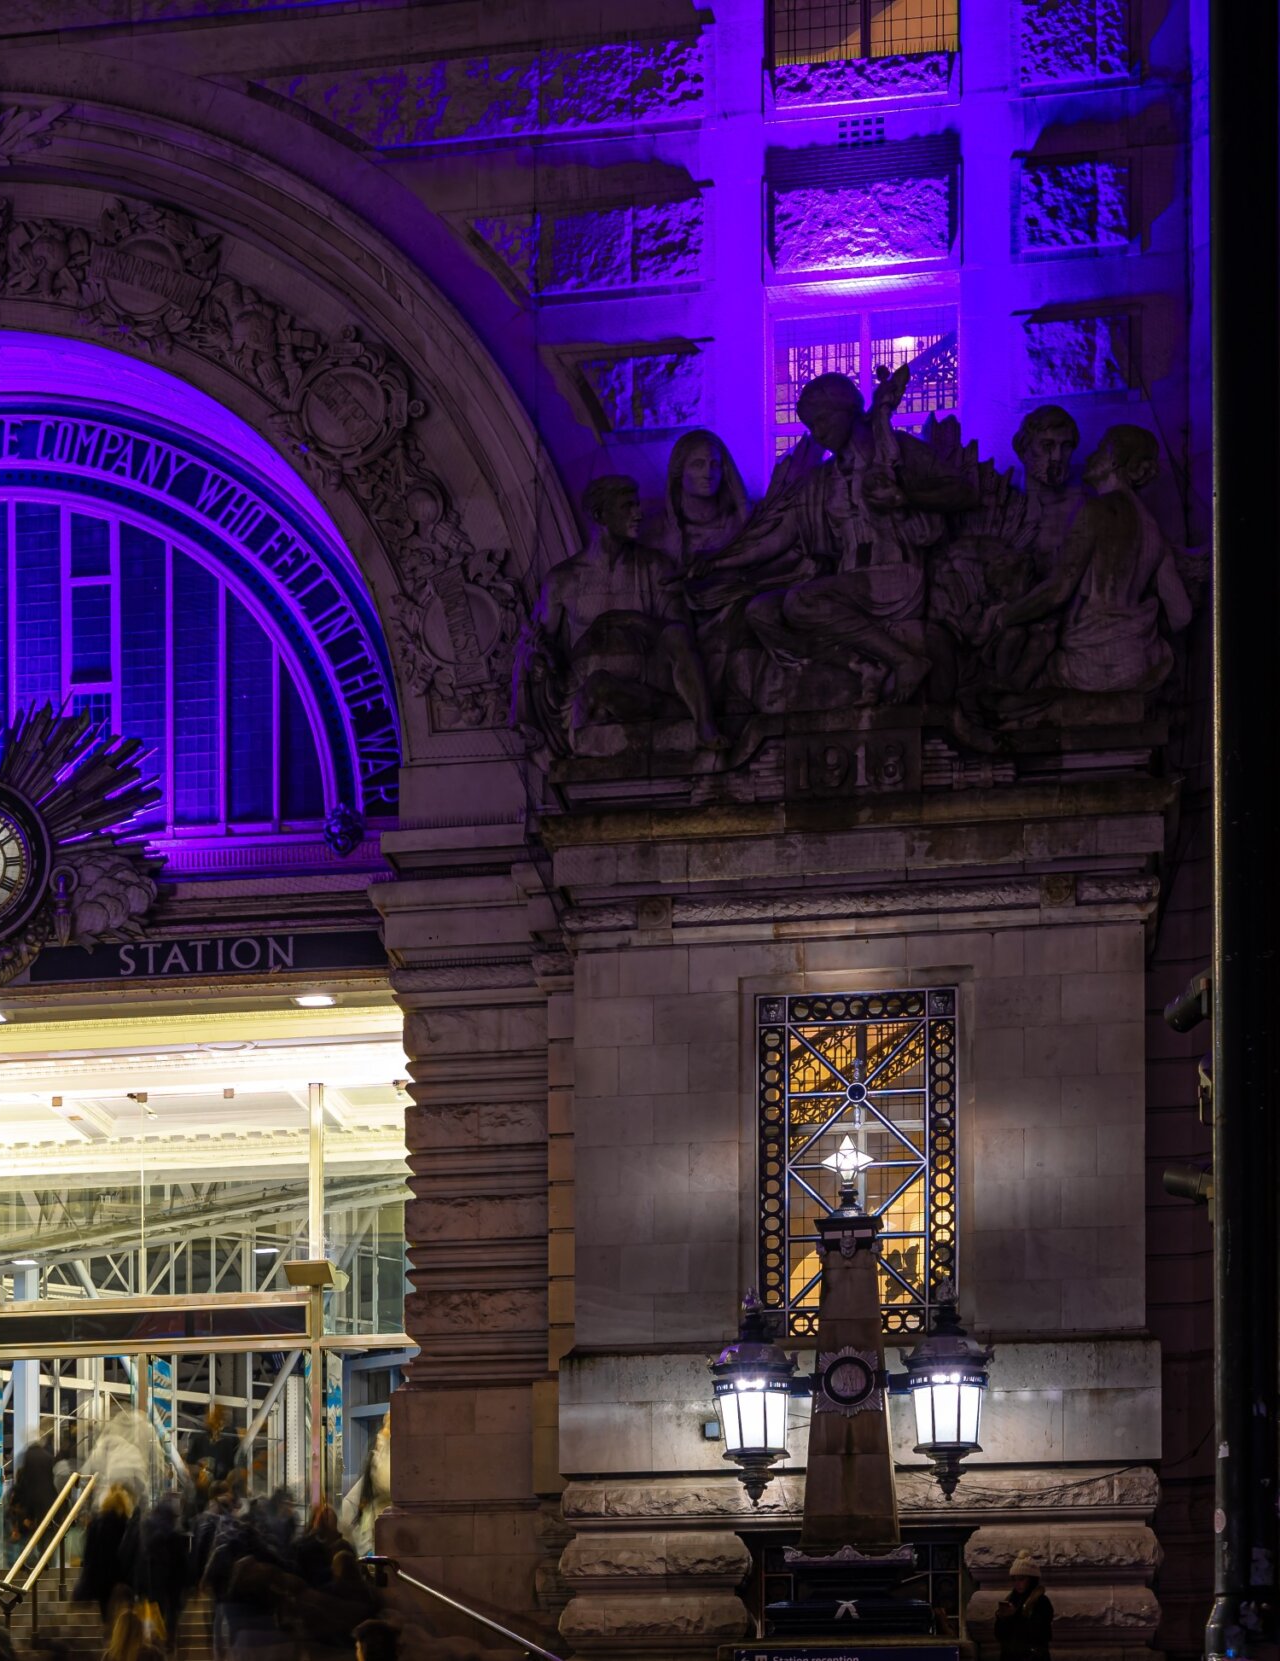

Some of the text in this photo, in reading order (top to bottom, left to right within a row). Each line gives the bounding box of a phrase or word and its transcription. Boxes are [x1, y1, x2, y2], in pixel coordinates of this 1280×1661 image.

[36, 421, 192, 493] COMPANY
[195, 470, 267, 542] WHO
[256, 526, 327, 608] FELL
[310, 601, 359, 646] IN
[451, 632, 484, 682] SEA
[335, 641, 388, 719] THE
[357, 724, 399, 806] WAR
[795, 742, 906, 791] 1918
[119, 936, 294, 976] STATION
